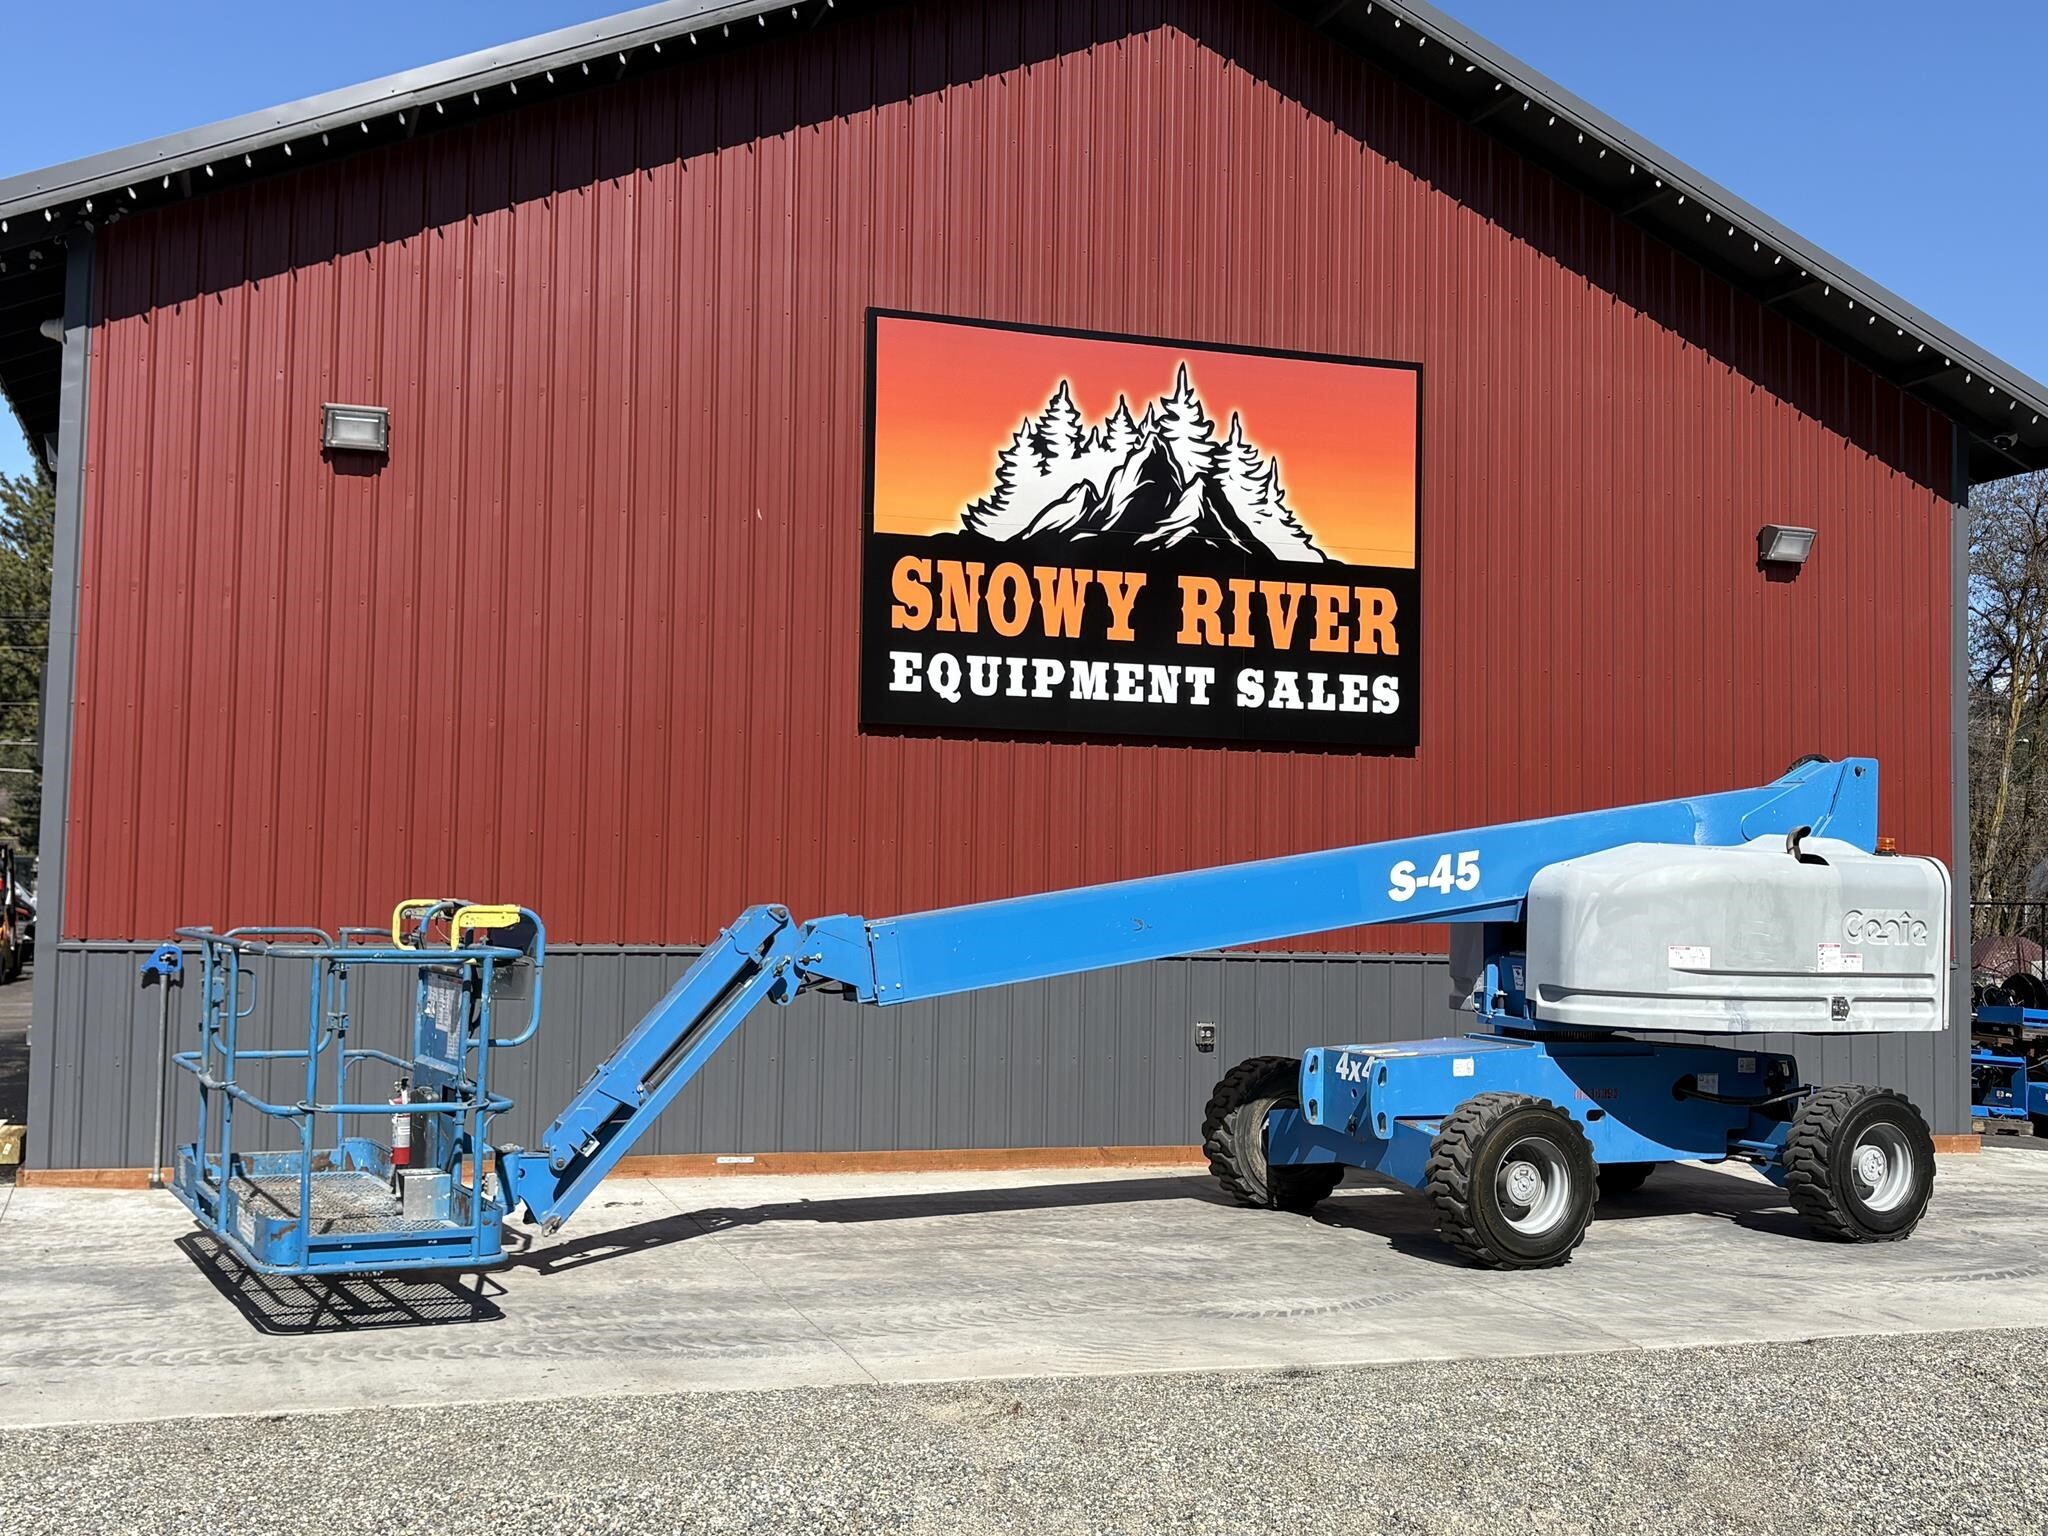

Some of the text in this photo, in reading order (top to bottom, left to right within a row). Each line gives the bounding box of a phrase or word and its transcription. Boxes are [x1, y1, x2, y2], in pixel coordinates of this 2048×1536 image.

[891, 555, 1399, 655] SNOWY RIVER
[889, 650, 1399, 714] EQUIPMENT SALES
[1388, 850, 1480, 901] S-45
[1842, 909, 1928, 945] Genie
